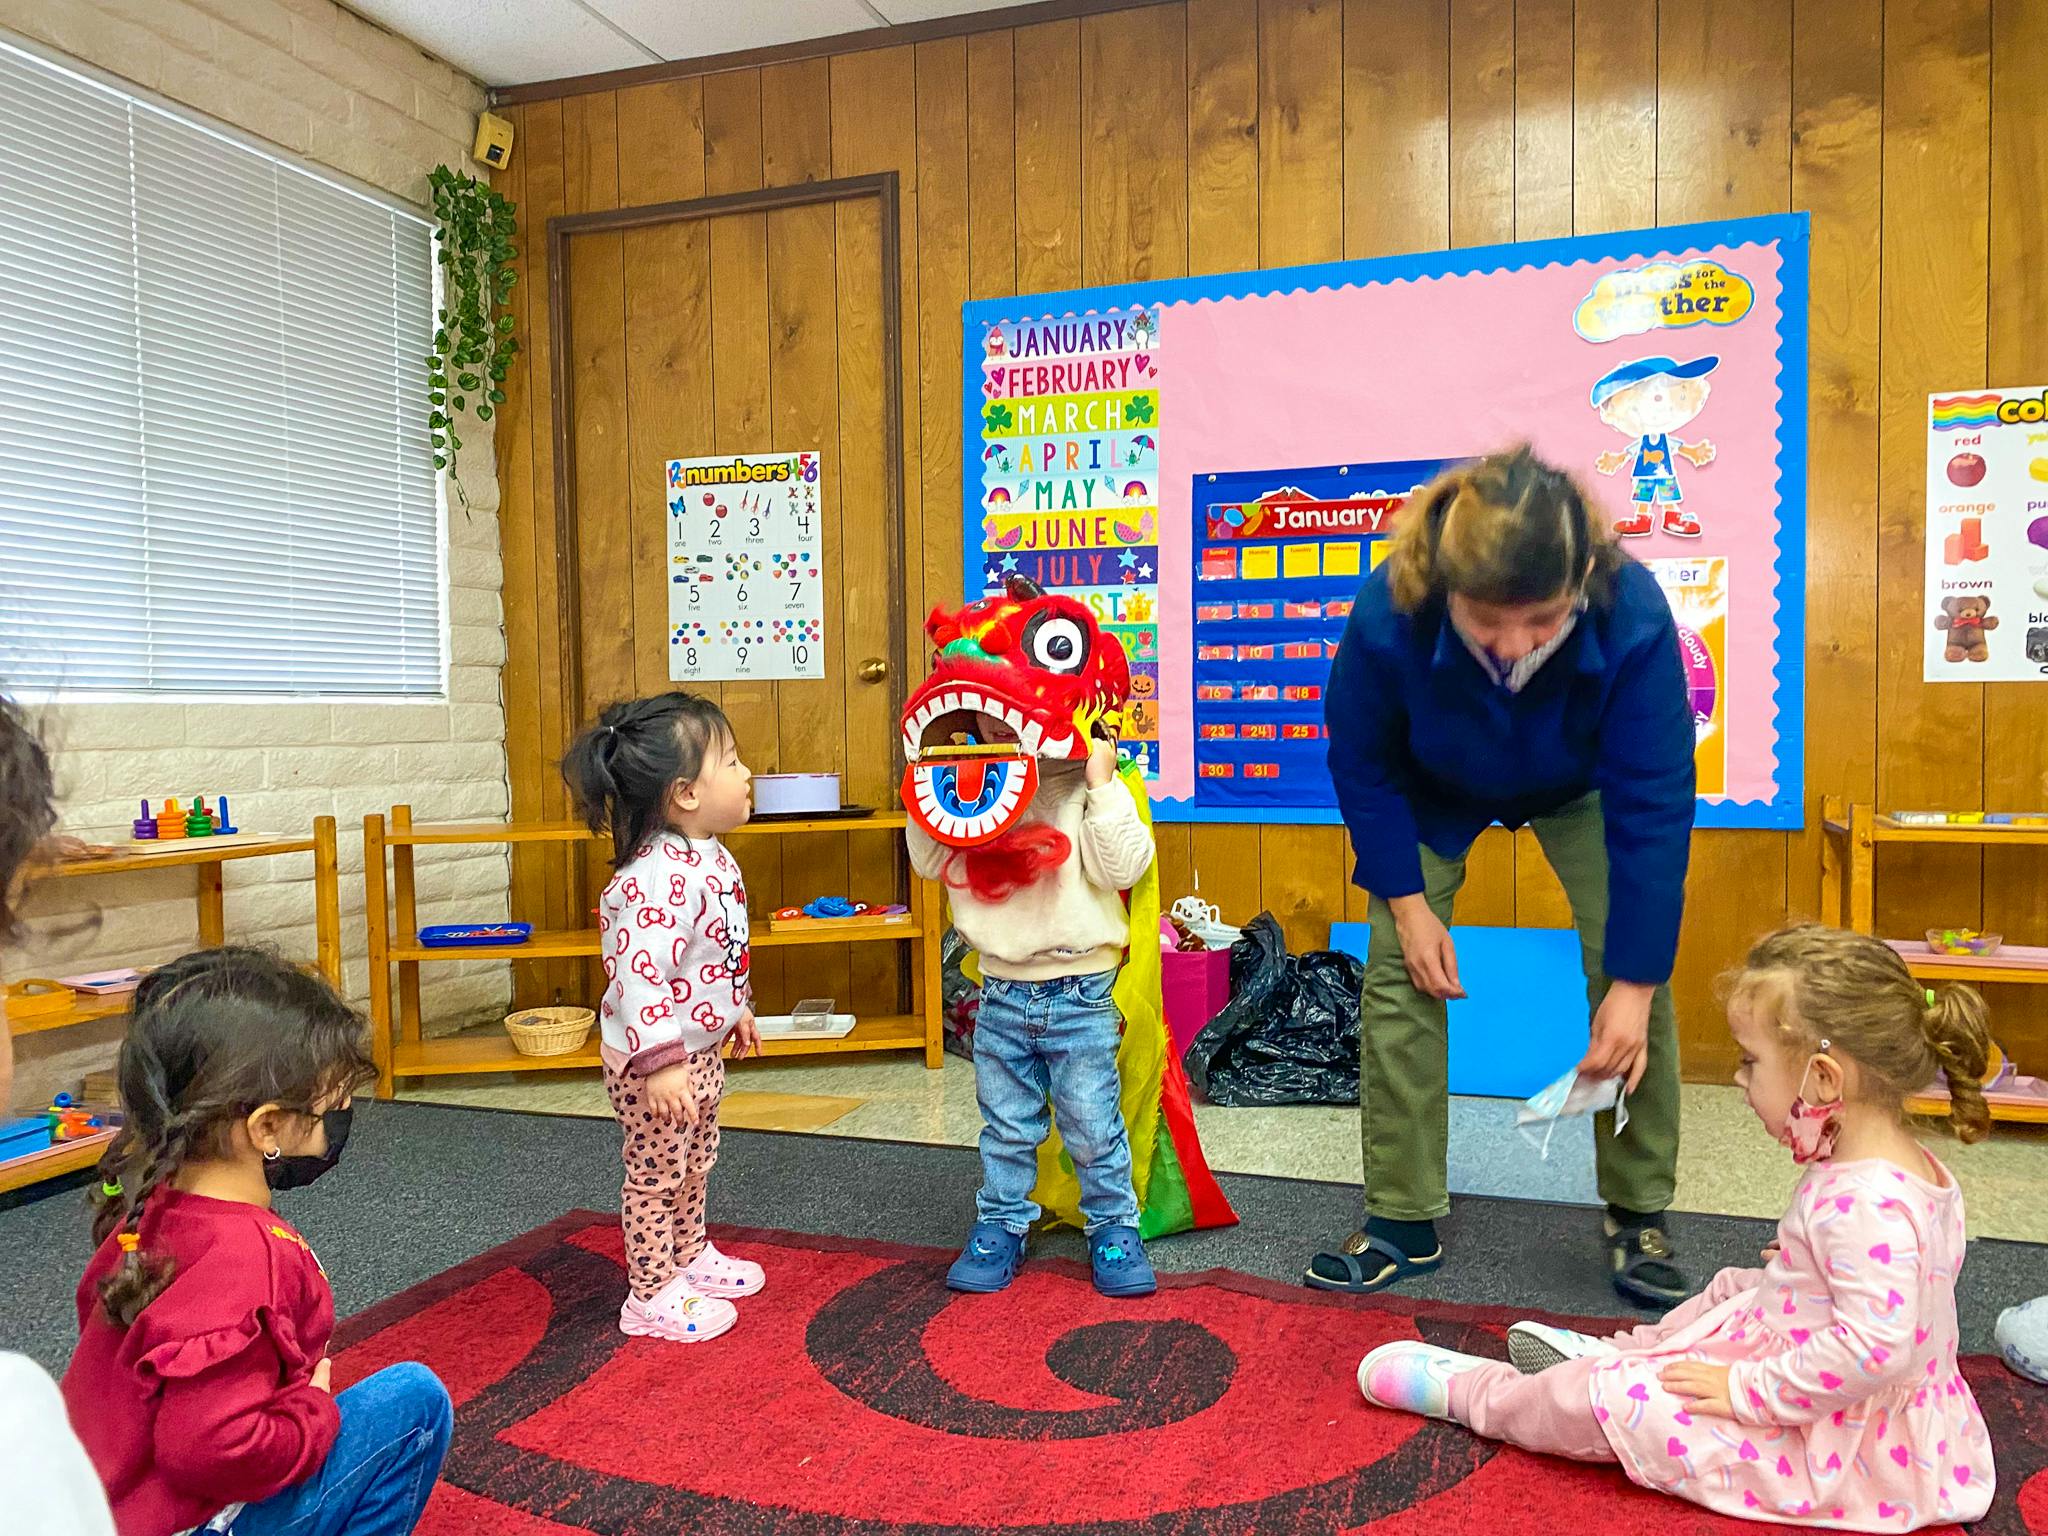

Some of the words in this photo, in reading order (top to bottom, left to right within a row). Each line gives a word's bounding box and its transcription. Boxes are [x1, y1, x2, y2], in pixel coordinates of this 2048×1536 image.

[1695, 269, 1716, 279] for
[1704, 279, 1726, 290] the
[1008, 318, 1127, 359] JANUARY
[1008, 357, 1132, 398] FEBRUARY
[1018, 399, 1121, 435] MARCH
[1954, 434, 1982, 447] red
[1018, 439, 1123, 473] APRIL
[686, 457, 790, 487] numbers
[1035, 478, 1096, 511] MAY
[1938, 502, 1996, 516] orange
[2027, 500, 2048, 512] pu
[709, 519, 721, 538] 2
[749, 517, 760, 537] 3
[797, 515, 810, 535] 4
[1272, 506, 1384, 530] January
[674, 540, 687, 548] one
[708, 538, 722, 546] two
[745, 536, 764, 544] three
[797, 533, 814, 542] four
[1024, 516, 1107, 549] JUNE
[1033, 554, 1103, 587] JULY
[689, 584, 700, 603] 5
[736, 583, 748, 602] 6
[789, 582, 802, 601] 7
[1941, 579, 1994, 590] brown
[688, 603, 701, 611] five
[737, 603, 749, 611] six
[784, 602, 806, 610] seven
[1210, 607, 1219, 616] 2
[1250, 606, 1259, 618] 3
[686, 647, 697, 666] 8
[736, 646, 748, 665] 9
[792, 645, 809, 664] 10
[1211, 647, 1220, 658] 9
[1249, 647, 1263, 658] 10
[1297, 645, 1307, 657] 11
[1677, 628, 1708, 670] cloudy
[683, 666, 701, 676] eight
[734, 666, 751, 674] nine
[1208, 687, 1221, 697] 16
[1295, 687, 1309, 698] 18
[1210, 725, 1226, 737] 23
[1250, 725, 1267, 737] 24
[1292, 725, 1309, 737] 25
[1208, 765, 1225, 776] 30
[1254, 765, 1268, 776] 31
